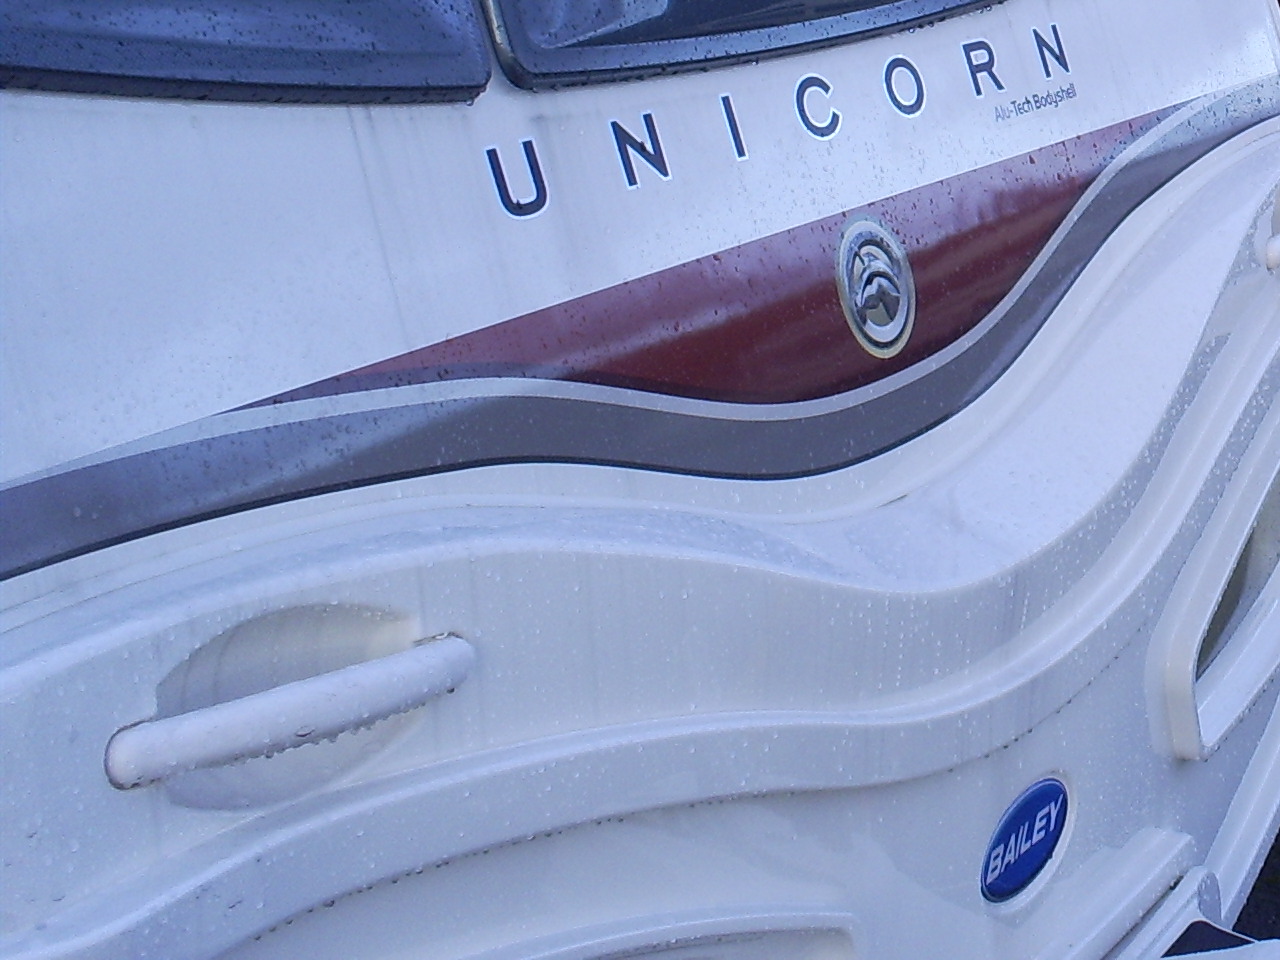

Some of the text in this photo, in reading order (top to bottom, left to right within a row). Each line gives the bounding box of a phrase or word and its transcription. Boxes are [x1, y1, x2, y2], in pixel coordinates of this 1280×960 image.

[486, 23, 1072, 216] UNICORN
[994, 82, 1077, 122] Alu-Tech Bodyshell
[986, 793, 1064, 886] BAILEY
